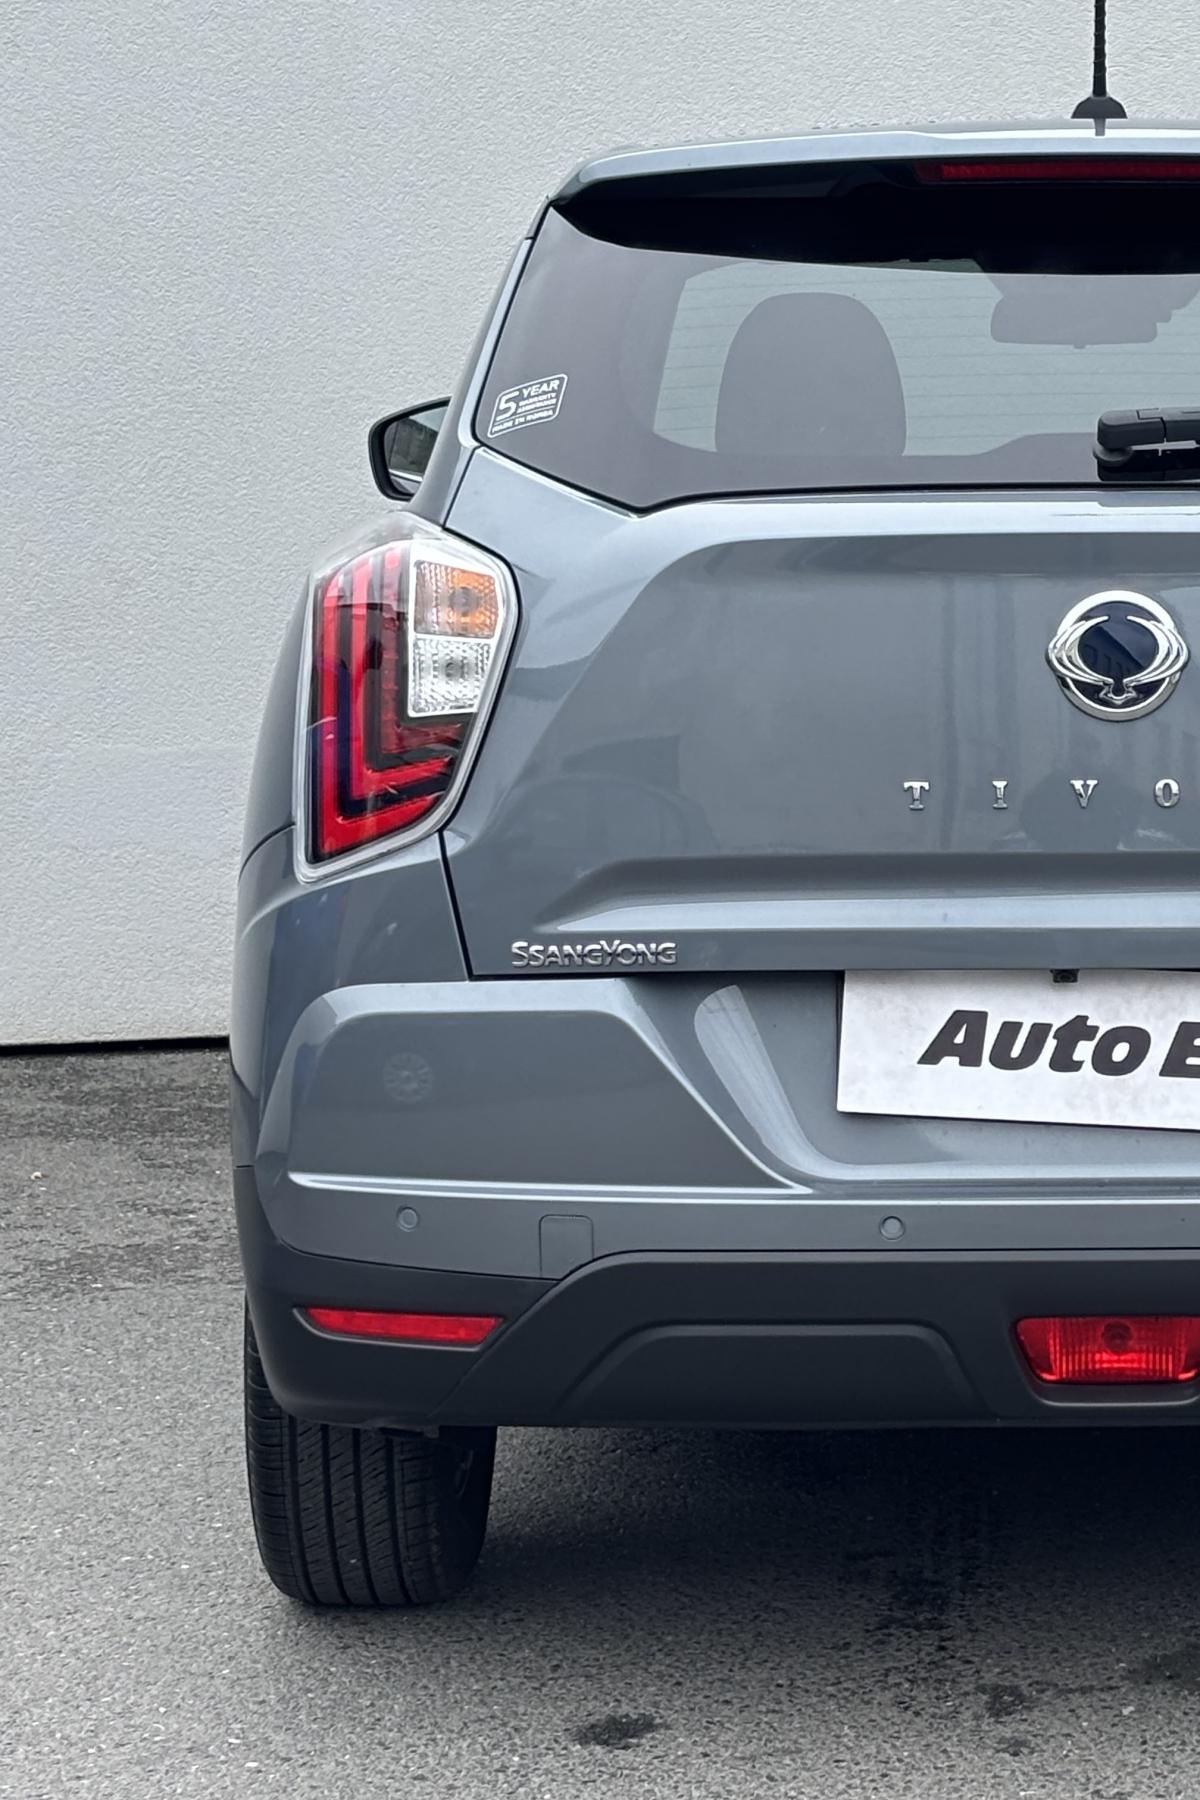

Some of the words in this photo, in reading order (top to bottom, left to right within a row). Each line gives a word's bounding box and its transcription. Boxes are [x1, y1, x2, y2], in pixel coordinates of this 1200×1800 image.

[496, 391, 519, 421] 5
[522, 380, 559, 398] YEAR
[917, 1009, 1151, 1076] Auto
